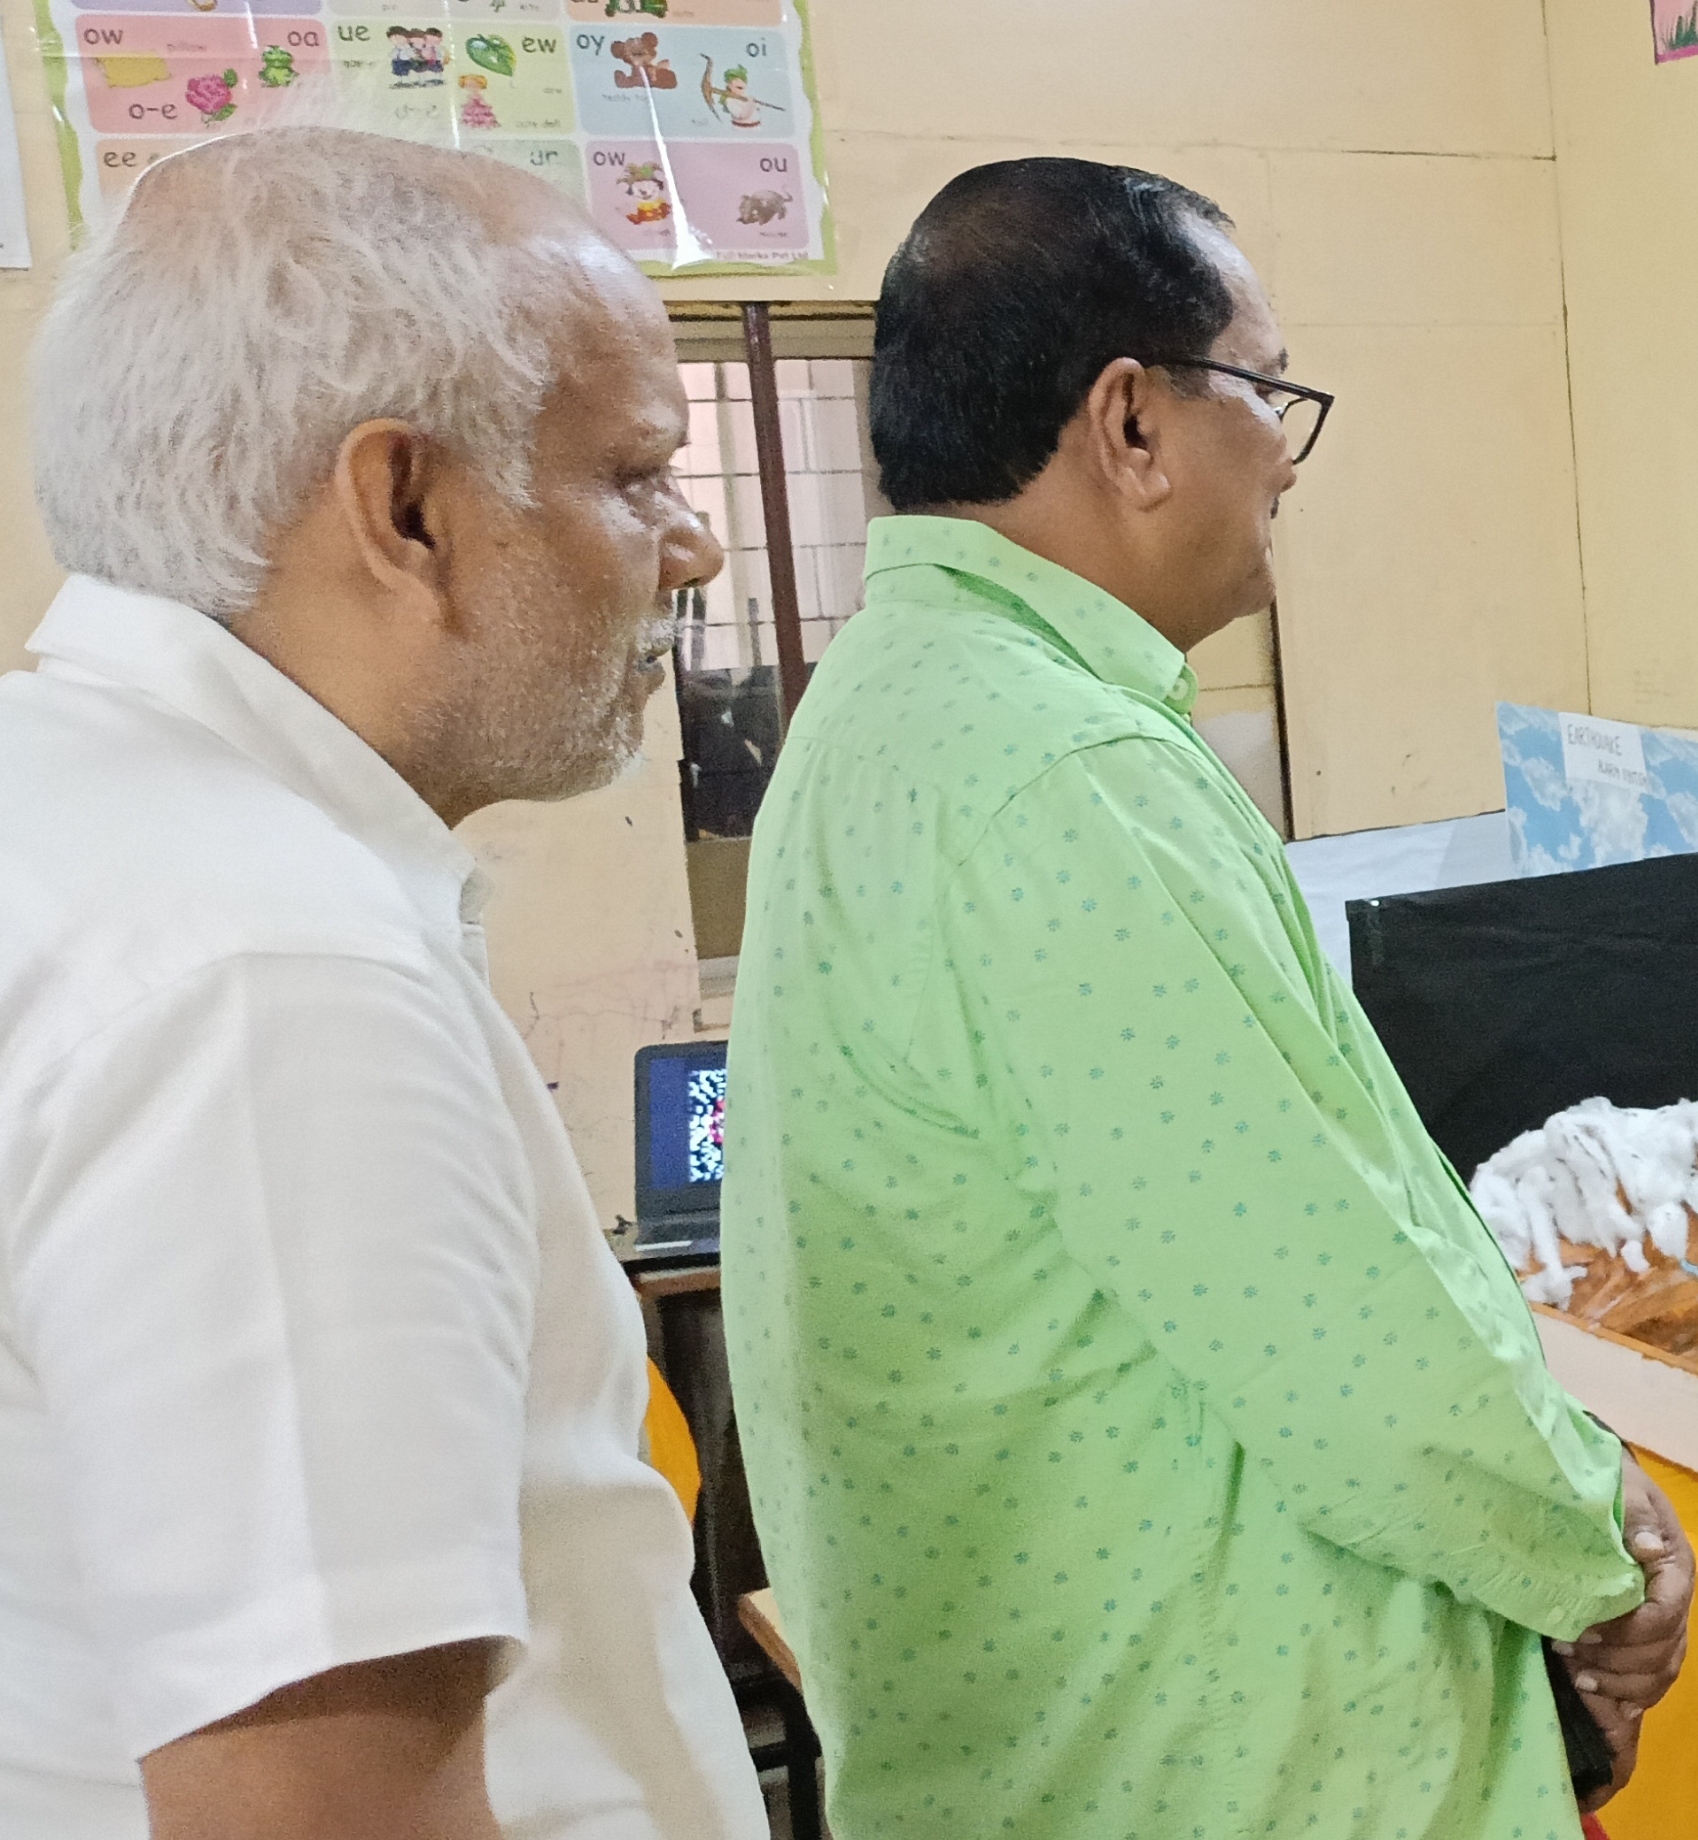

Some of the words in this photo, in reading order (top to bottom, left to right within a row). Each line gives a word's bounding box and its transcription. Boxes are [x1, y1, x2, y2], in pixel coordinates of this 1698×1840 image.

[83, 28, 123, 45] ow
[287, 31, 320, 47] oa
[337, 25, 370, 41] ue
[521, 36, 557, 53] ew
[576, 34, 605, 55] oy
[745, 38, 767, 57] oi
[103, 151, 137, 167] ee
[593, 151, 626, 166] ow
[759, 158, 788, 172] ou
